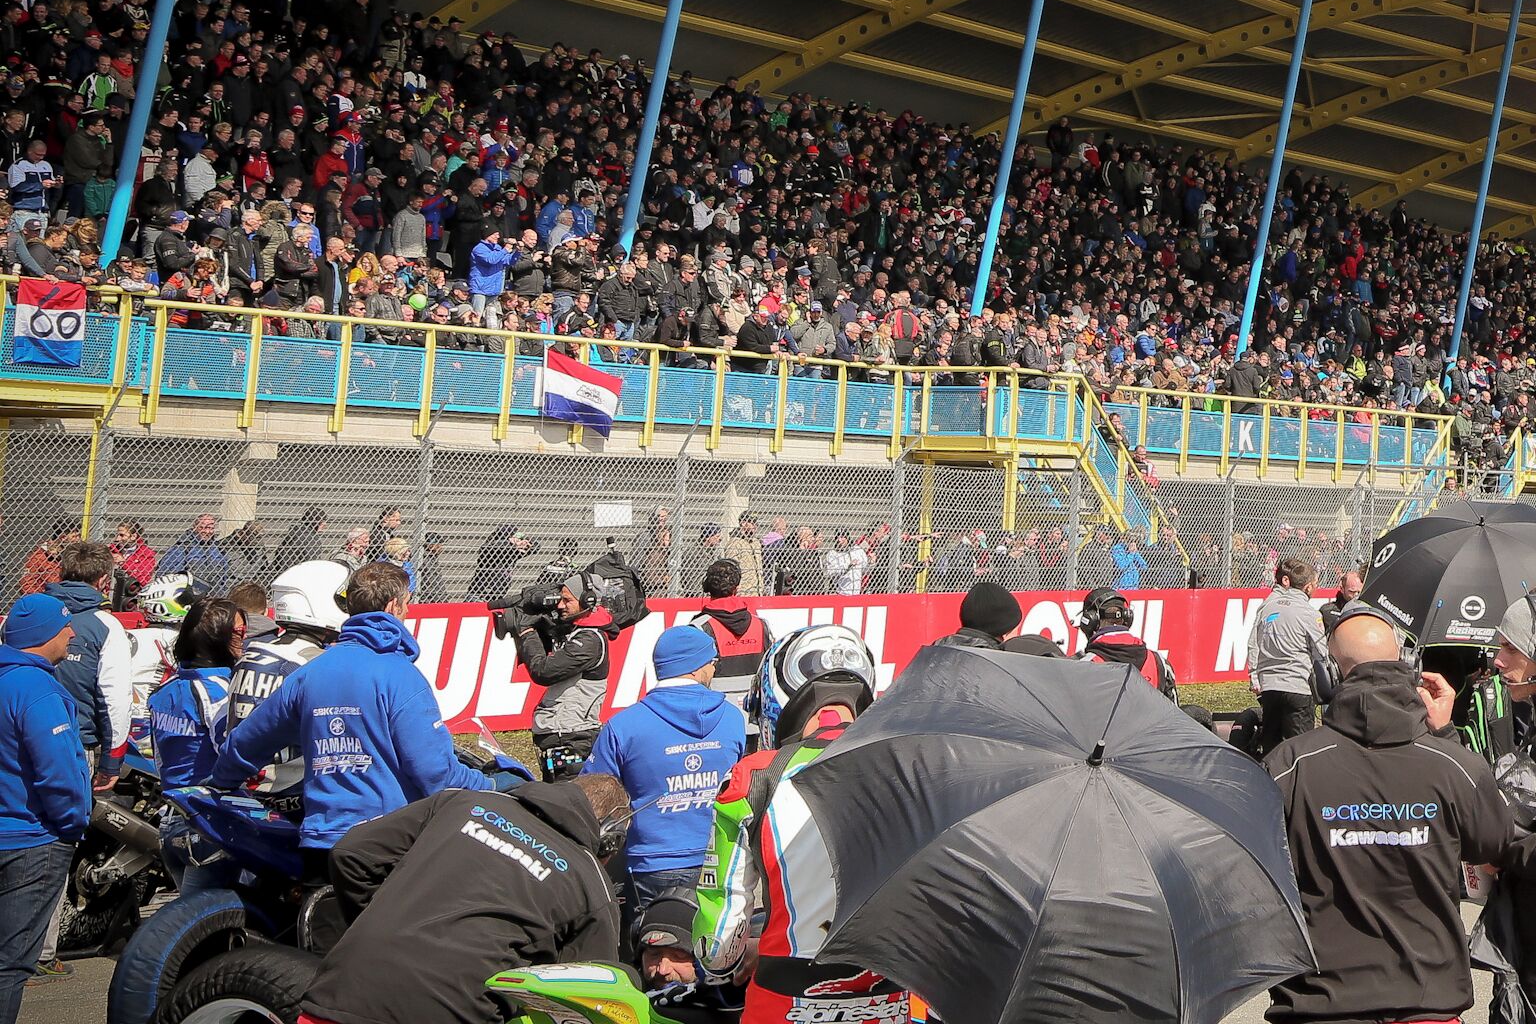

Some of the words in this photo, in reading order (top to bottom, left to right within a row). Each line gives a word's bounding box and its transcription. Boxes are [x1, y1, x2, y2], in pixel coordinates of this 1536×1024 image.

[1238, 420, 1255, 451] K
[1377, 592, 1416, 627] Kawasaki
[156, 711, 197, 736] YAMAHA
[314, 737, 364, 755] YAMAHA
[665, 770, 719, 792] YAMAHA
[1329, 825, 1430, 848] Kawasaki
[460, 820, 552, 882] Kawasaki
[786, 998, 910, 1024] alpinestars
